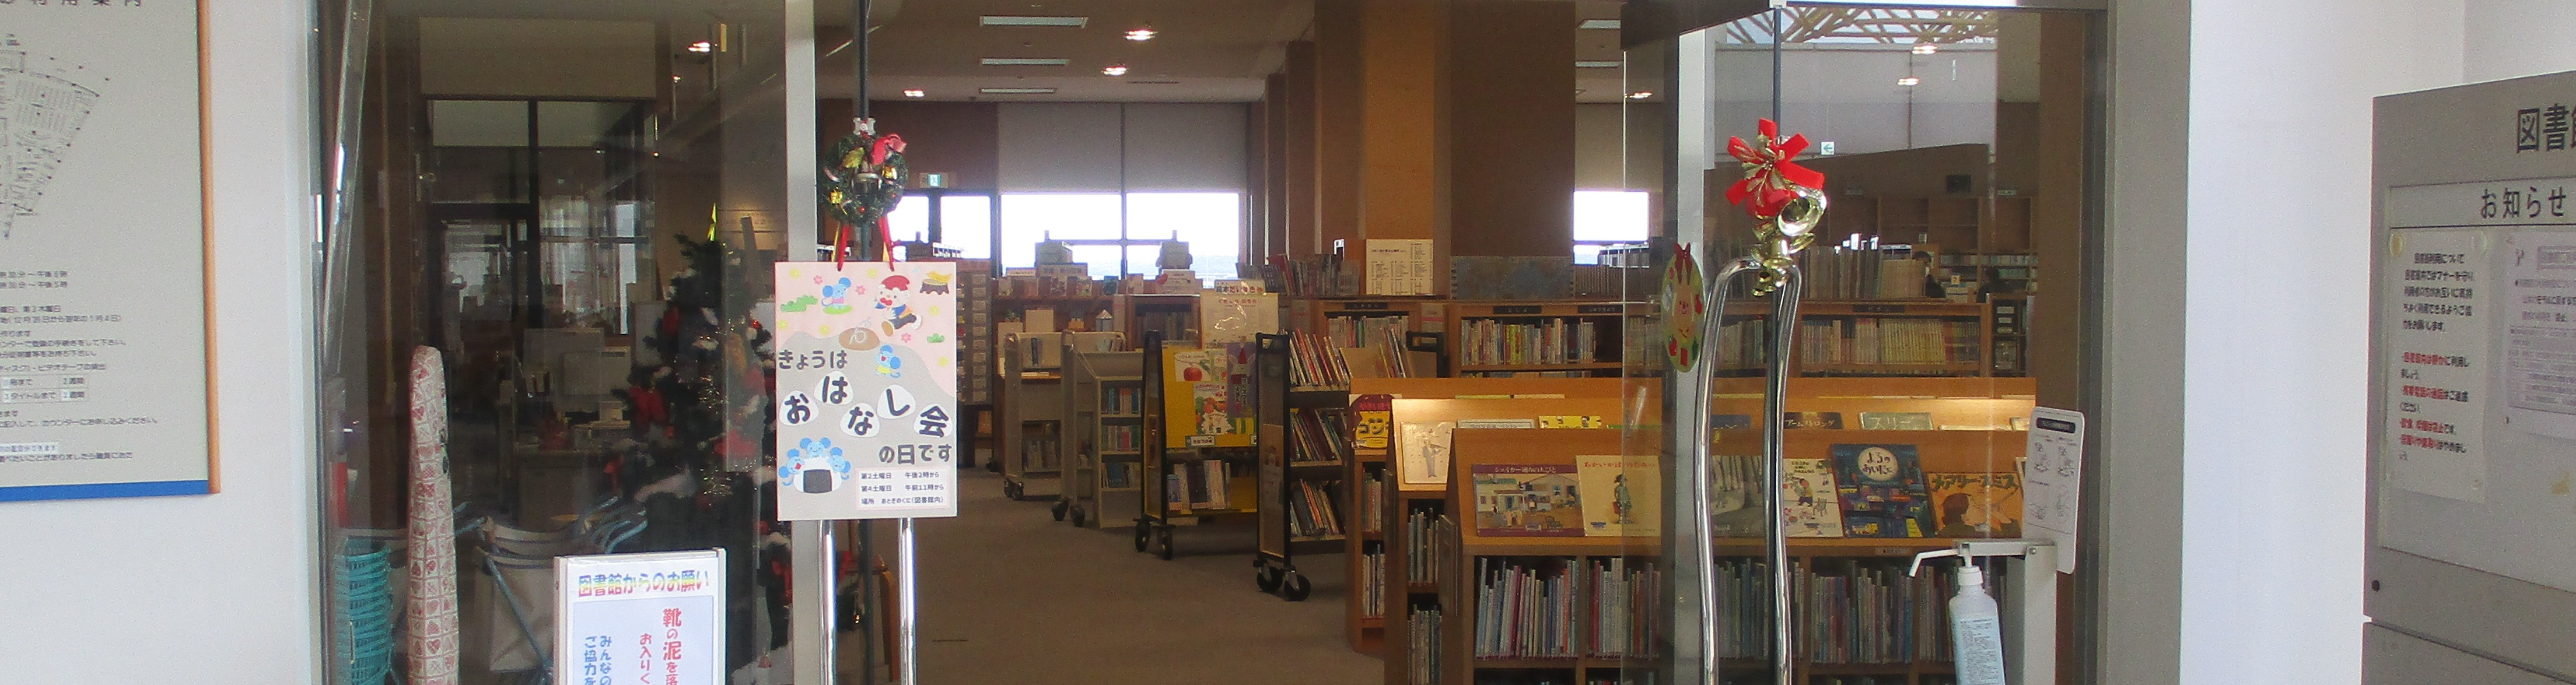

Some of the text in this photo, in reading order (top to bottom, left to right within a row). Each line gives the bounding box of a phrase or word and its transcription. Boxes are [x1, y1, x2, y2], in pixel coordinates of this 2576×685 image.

[2480, 186, 2566, 219] お知らせ
[778, 349, 848, 370] きょうは
[784, 375, 949, 438] おはなし会
[878, 444, 952, 465] の日です
[1867, 452, 1890, 463] よるの
[578, 570, 709, 597] 図書館からのお願い
[600, 635, 612, 685] みんなの
